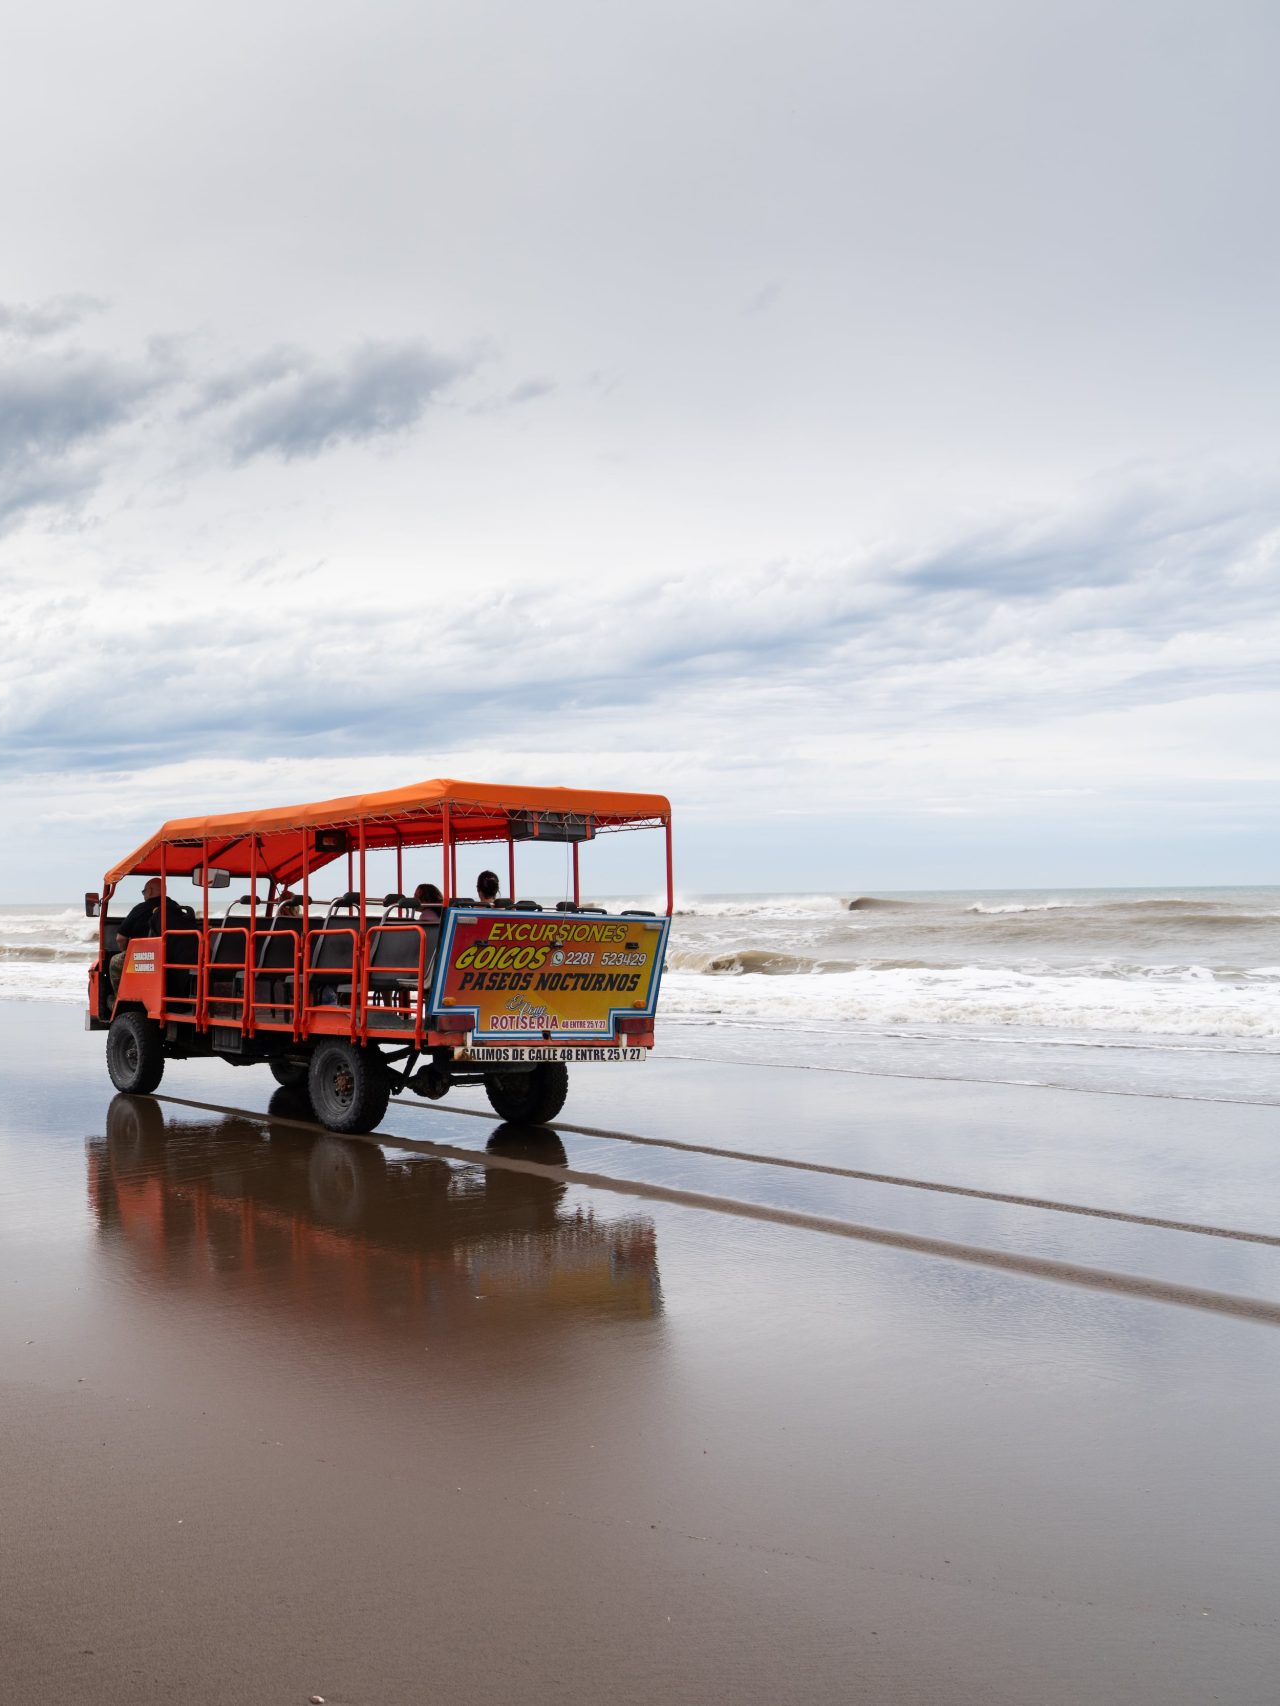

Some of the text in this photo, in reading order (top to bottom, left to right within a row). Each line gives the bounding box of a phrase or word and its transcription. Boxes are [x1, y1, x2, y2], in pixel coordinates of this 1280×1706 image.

[488, 923, 628, 942] EXCURSIONES
[455, 947, 550, 970] GOICOS
[565, 952, 646, 967] 2281 523429
[458, 972, 641, 992] PASEOS NOCTURNOS
[490, 1015, 559, 1030] ROTISERIA
[570, 1020, 586, 1029] ENTRE
[512, 1049, 525, 1061] DE
[528, 1049, 558, 1061] CALLE
[560, 1049, 573, 1061] 48
[575, 1049, 605, 1061] ENTRE
[608, 1049, 620, 1061] 25
[621, 1049, 629, 1061] Y
[630, 1049, 641, 1061] 27
